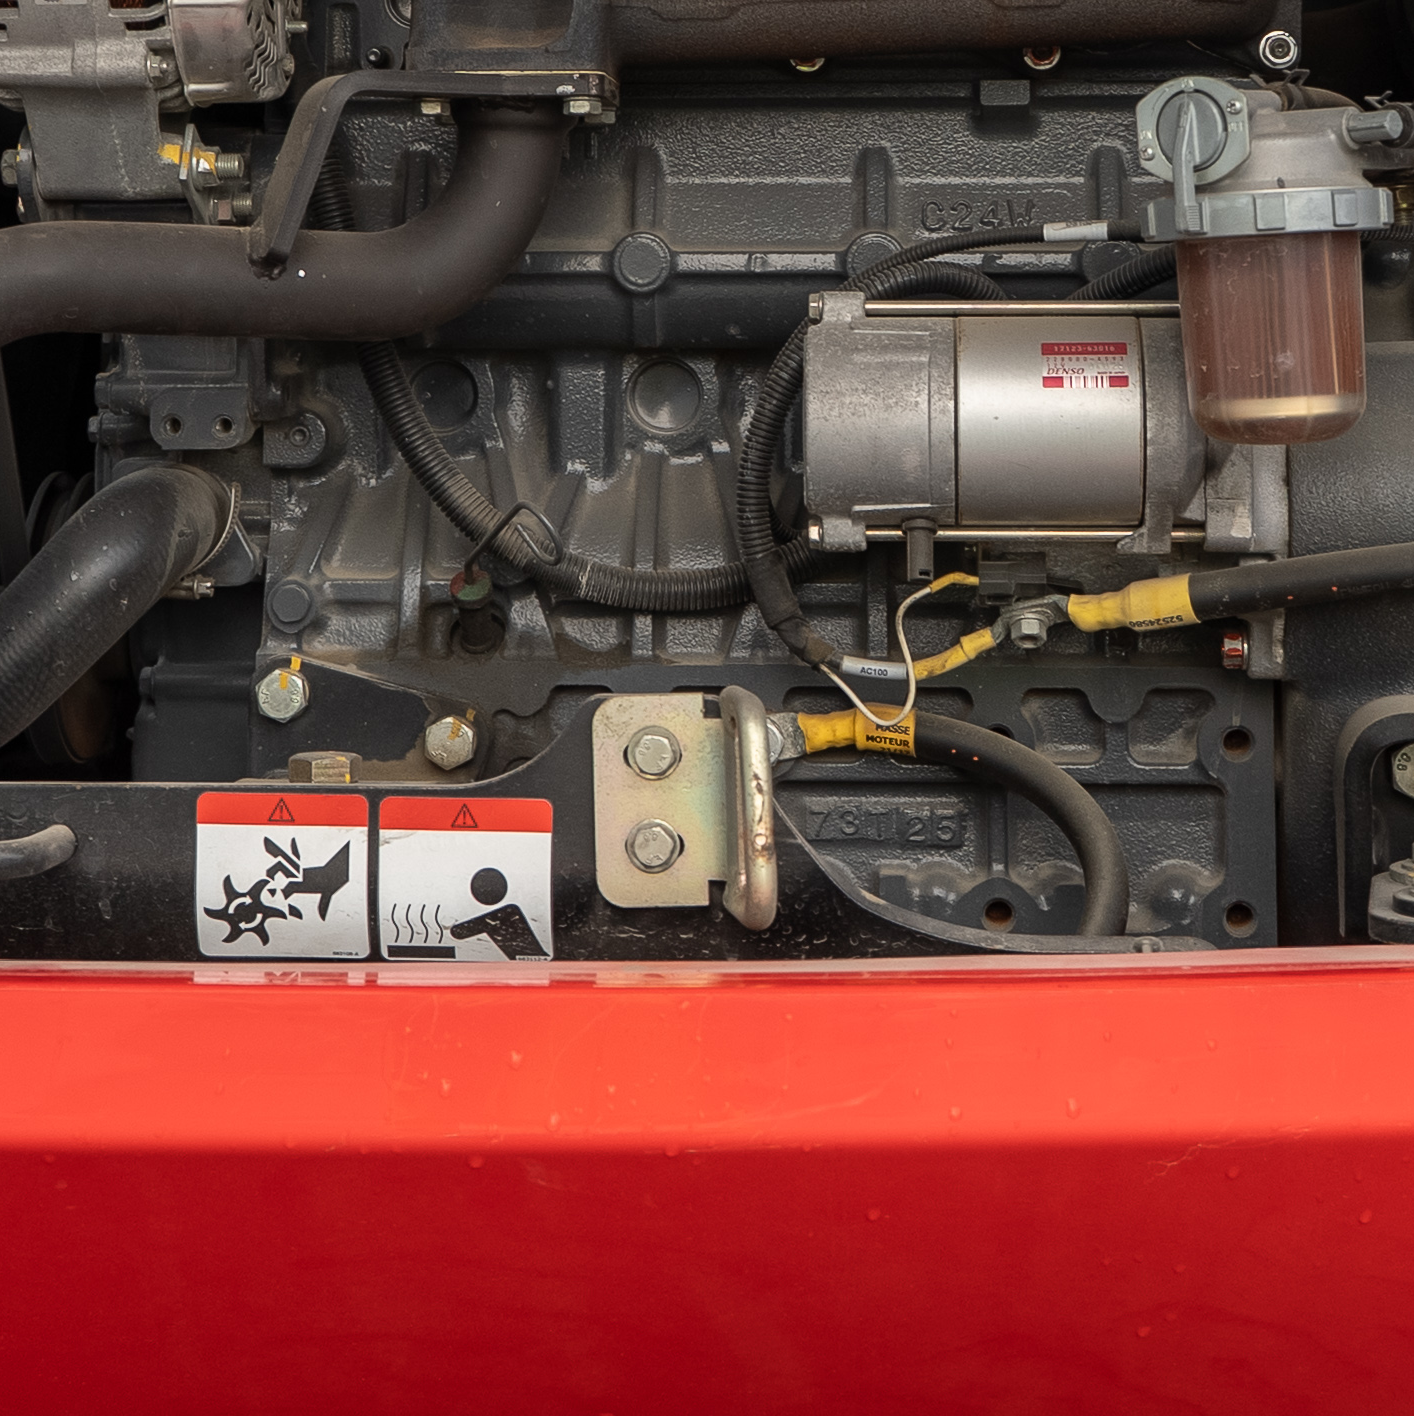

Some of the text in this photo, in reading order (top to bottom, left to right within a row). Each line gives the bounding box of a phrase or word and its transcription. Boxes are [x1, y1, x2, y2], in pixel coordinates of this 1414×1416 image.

[920, 198, 1037, 233] C24W
[1046, 367, 1085, 375] DENSO
[859, 666, 888, 677] AC100
[865, 734, 910, 749] MOTEUR
